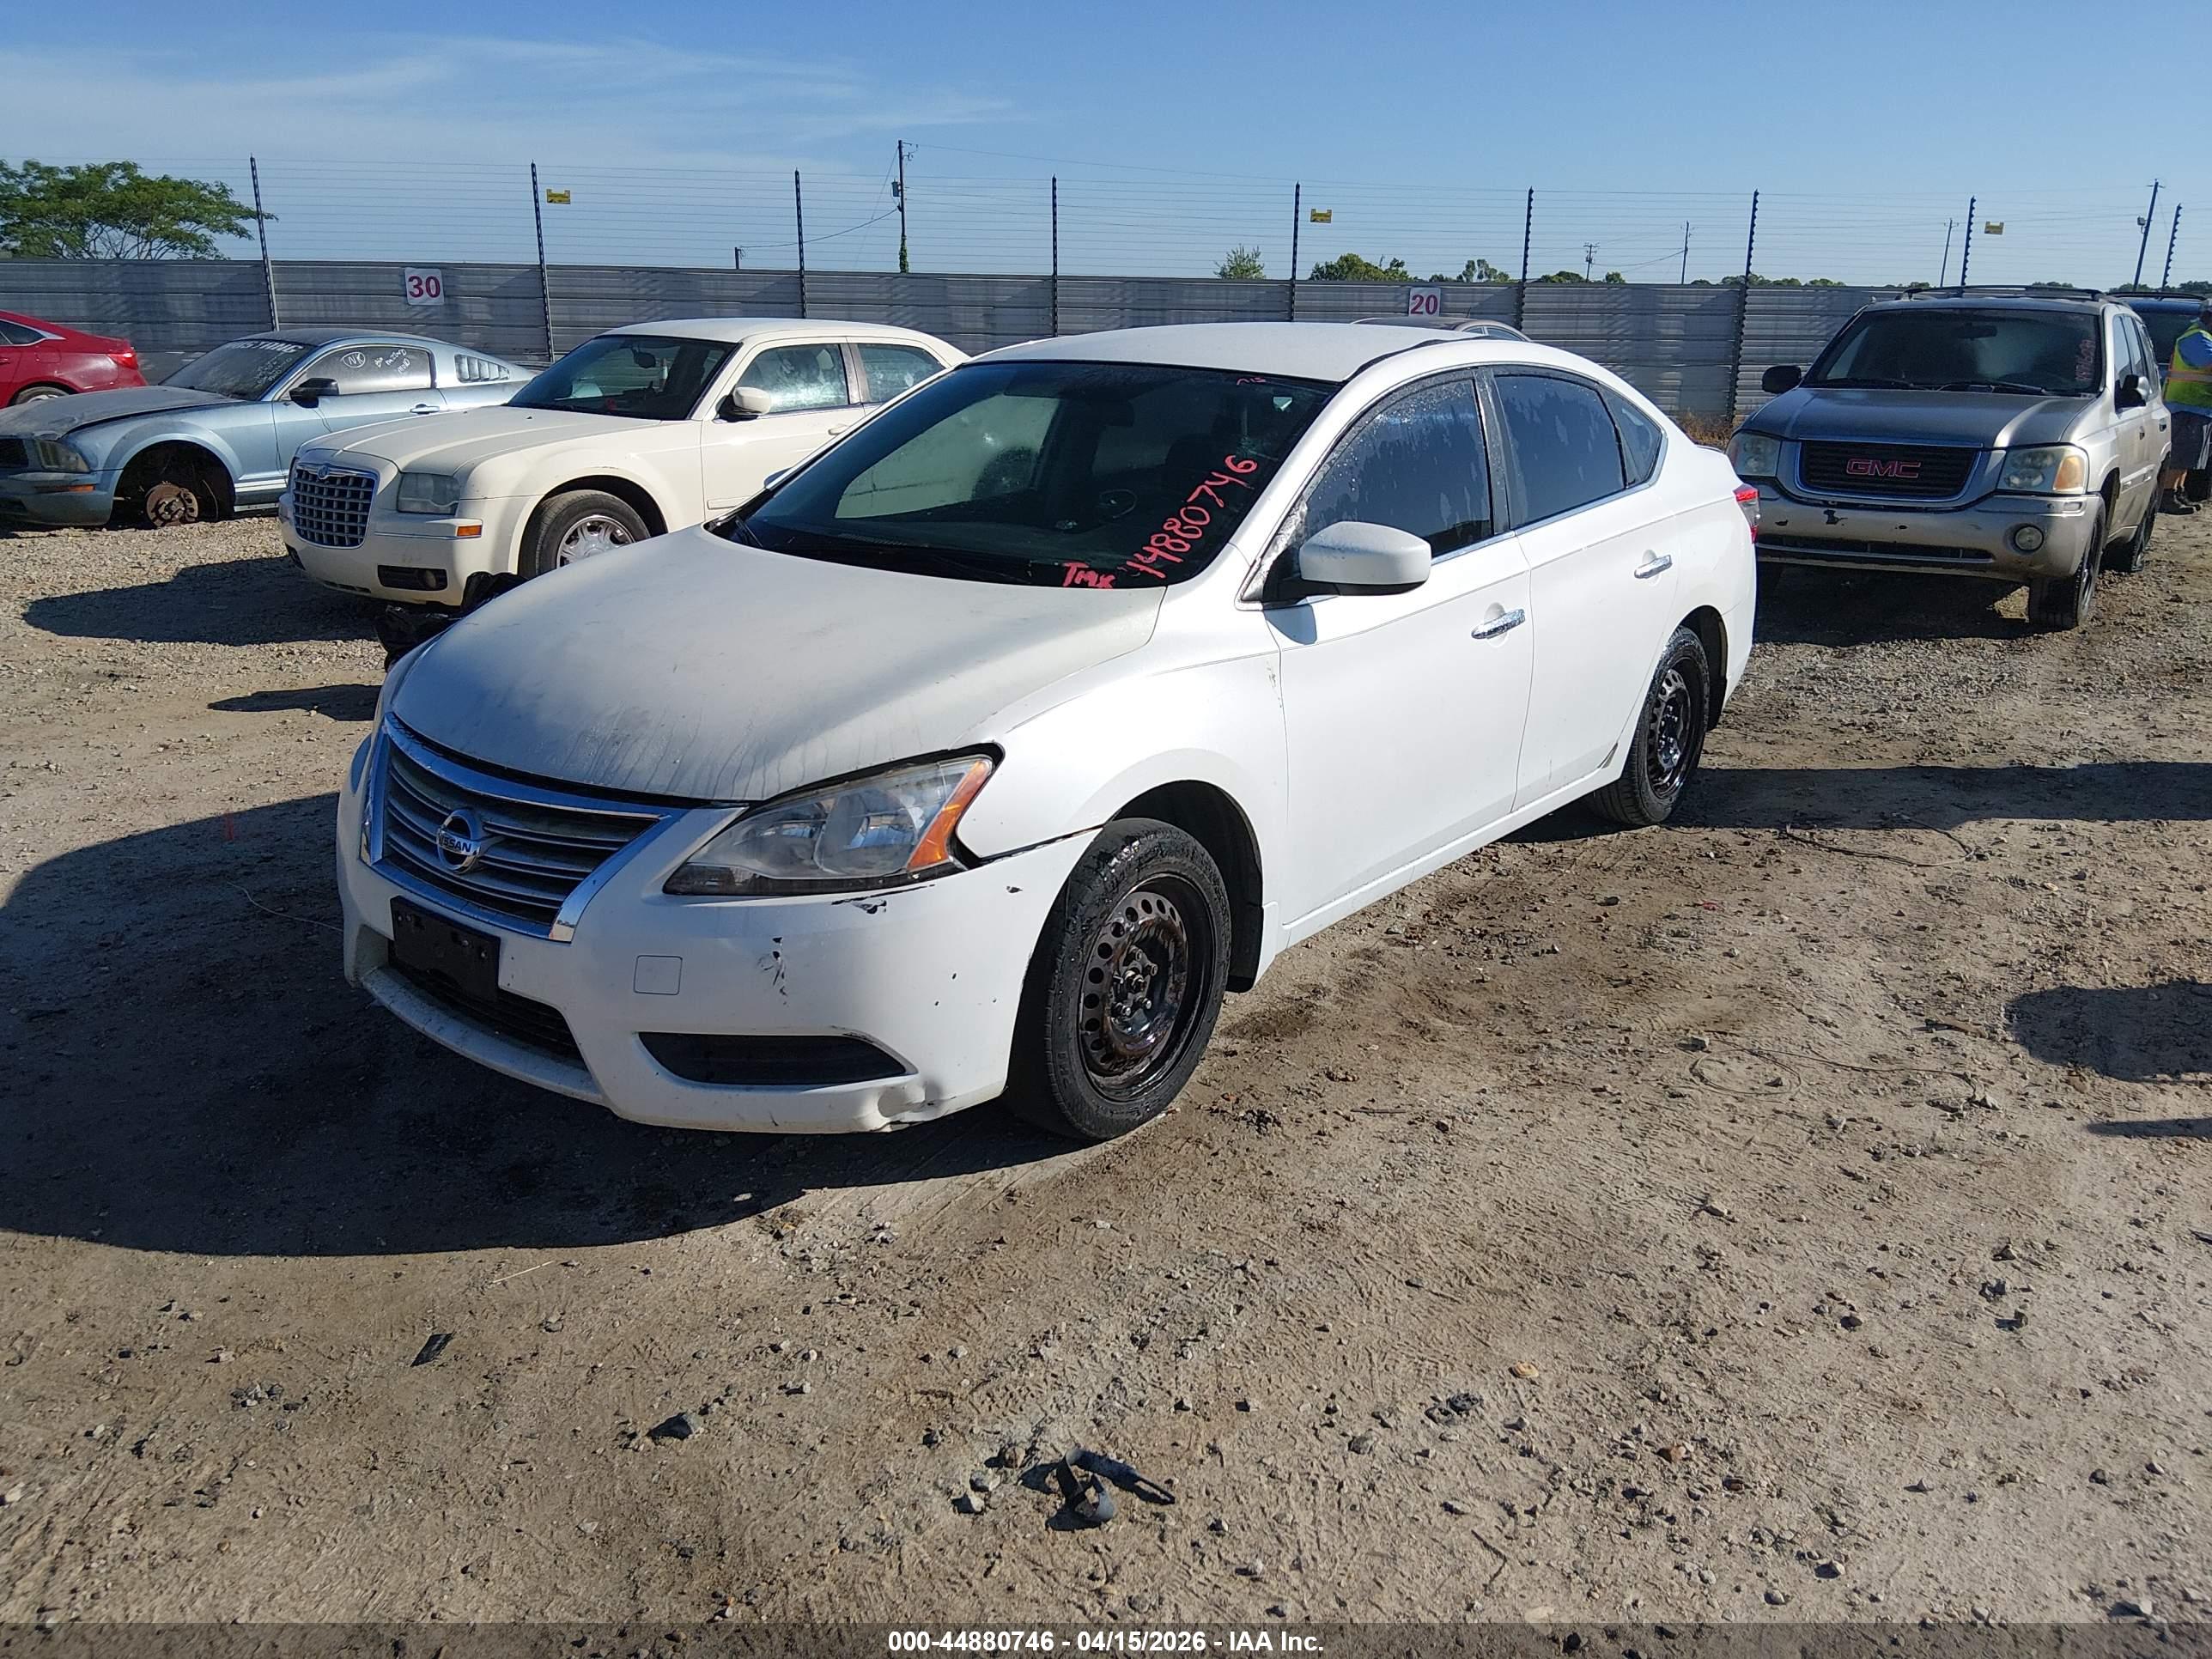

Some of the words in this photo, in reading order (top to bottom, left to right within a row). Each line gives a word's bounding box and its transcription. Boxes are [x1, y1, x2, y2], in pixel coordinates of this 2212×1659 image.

[408, 276, 441, 298] 30
[1411, 295, 1437, 315] 20
[1846, 459, 1921, 478] GMC
